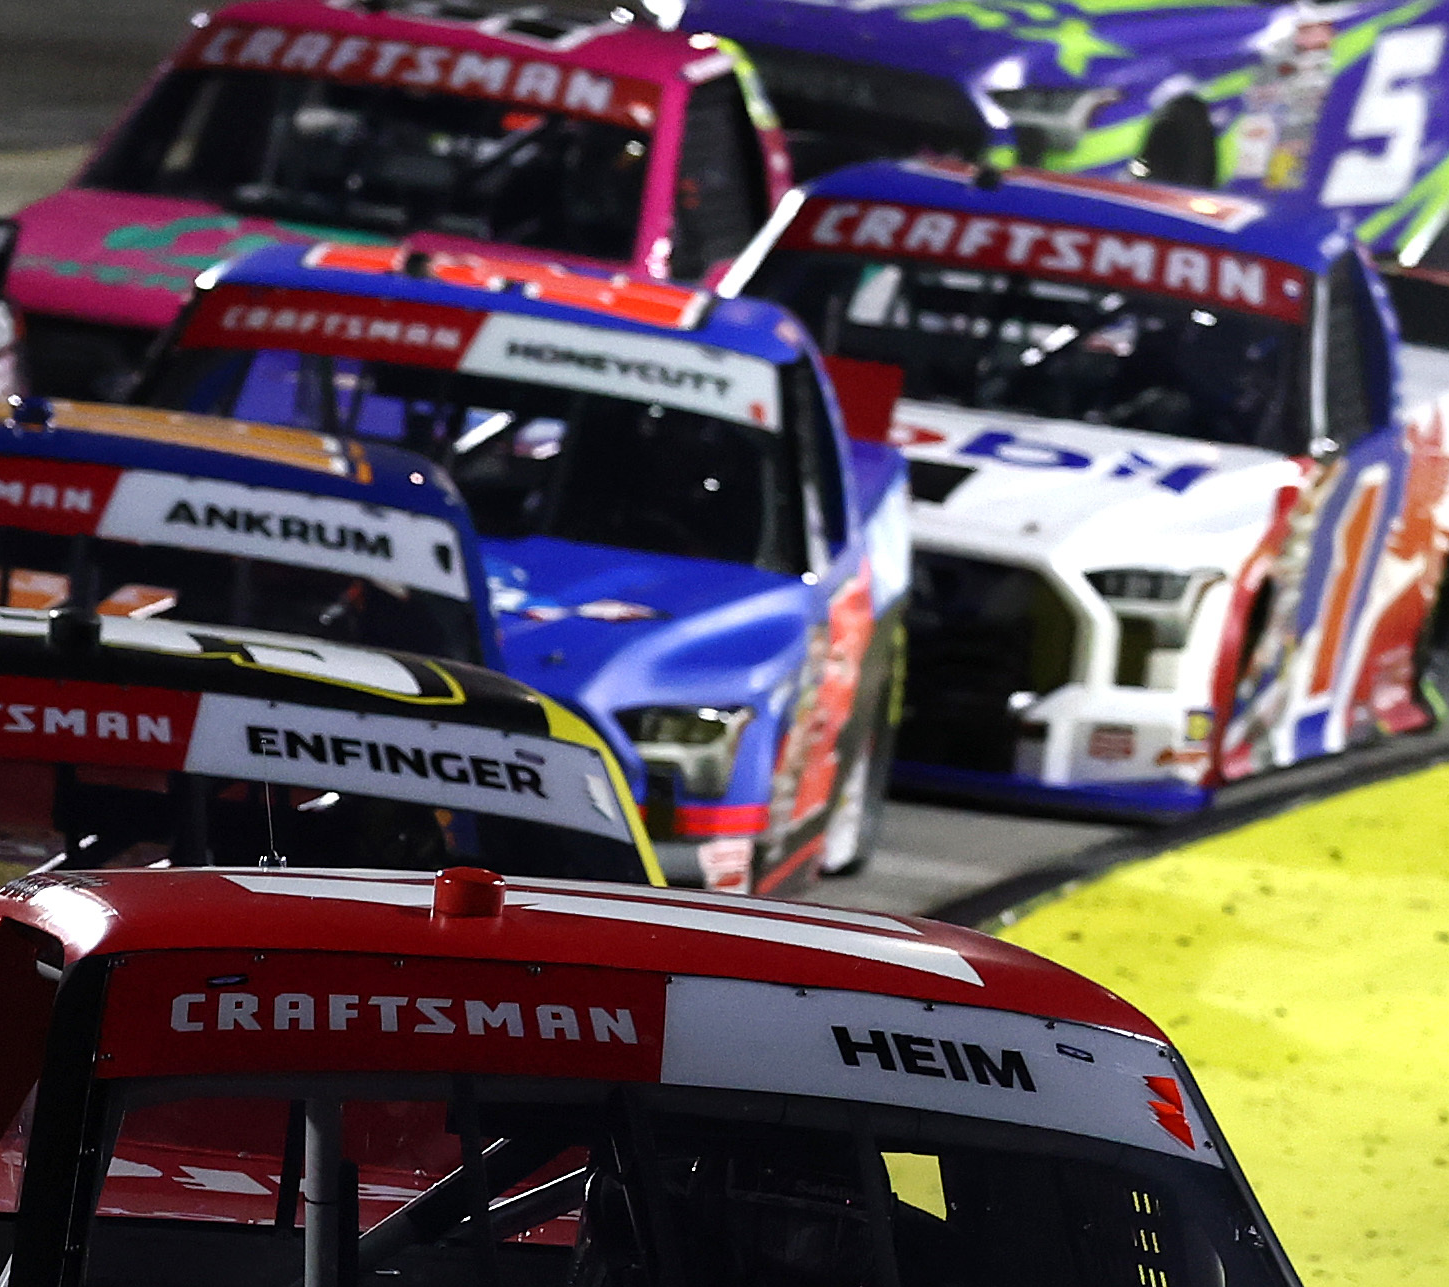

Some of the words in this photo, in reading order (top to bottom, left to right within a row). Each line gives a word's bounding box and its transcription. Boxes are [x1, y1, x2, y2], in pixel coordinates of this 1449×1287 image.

[199, 26, 615, 112] CRAFTSMAN
[1320, 24, 1448, 207] 5
[809, 204, 1268, 308] CRAFTSMAN
[219, 301, 465, 354] CRAFTSMAN
[505, 334, 737, 398] HONEYCUTT
[163, 498, 395, 562] ANKRUM
[245, 723, 551, 802] ENFINGER
[169, 992, 639, 1045] CRAFTSMAN
[829, 1025, 1037, 1093] HEIM
